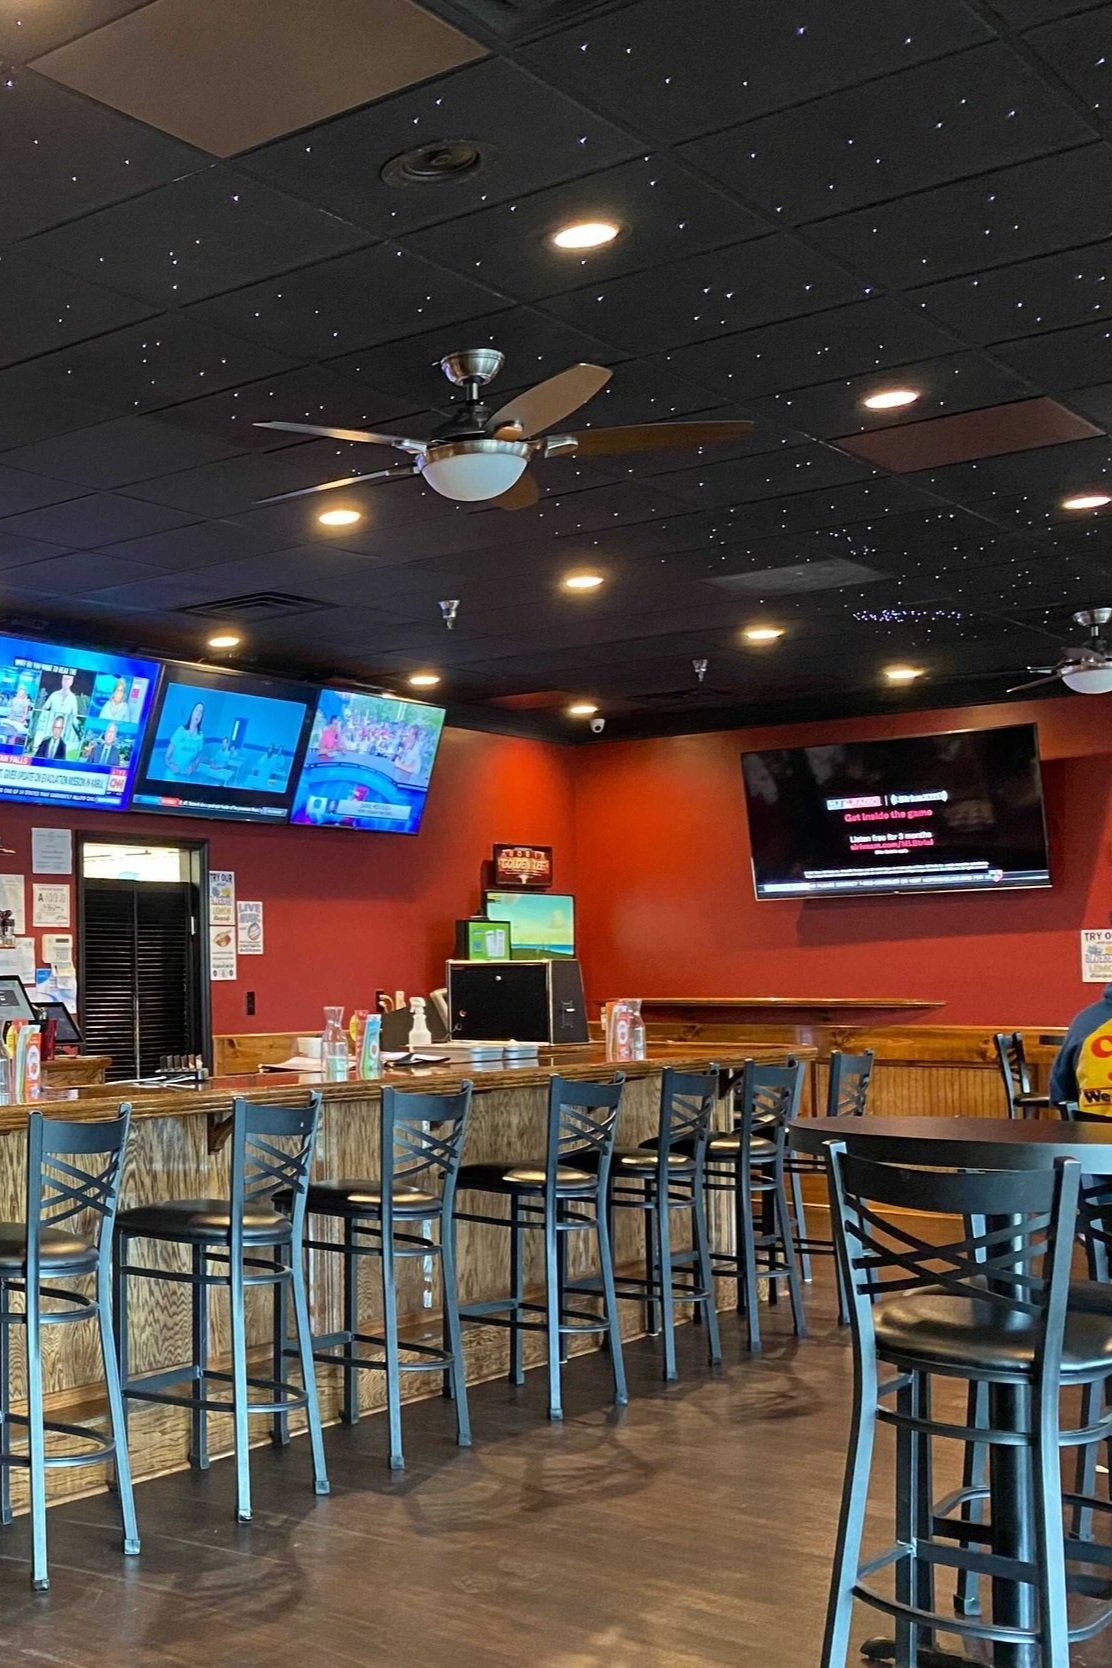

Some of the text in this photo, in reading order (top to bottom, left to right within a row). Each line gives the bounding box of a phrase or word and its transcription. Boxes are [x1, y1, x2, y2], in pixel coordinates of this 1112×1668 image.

[9, 756, 28, 765] FALLS
[844, 809, 933, 822] Get inside the game
[849, 831, 933, 843] Listen free for 3 months
[210, 873, 232, 883] TRY OUR
[238, 903, 261, 913] LIVE
[1084, 932, 1102, 942] TRY
